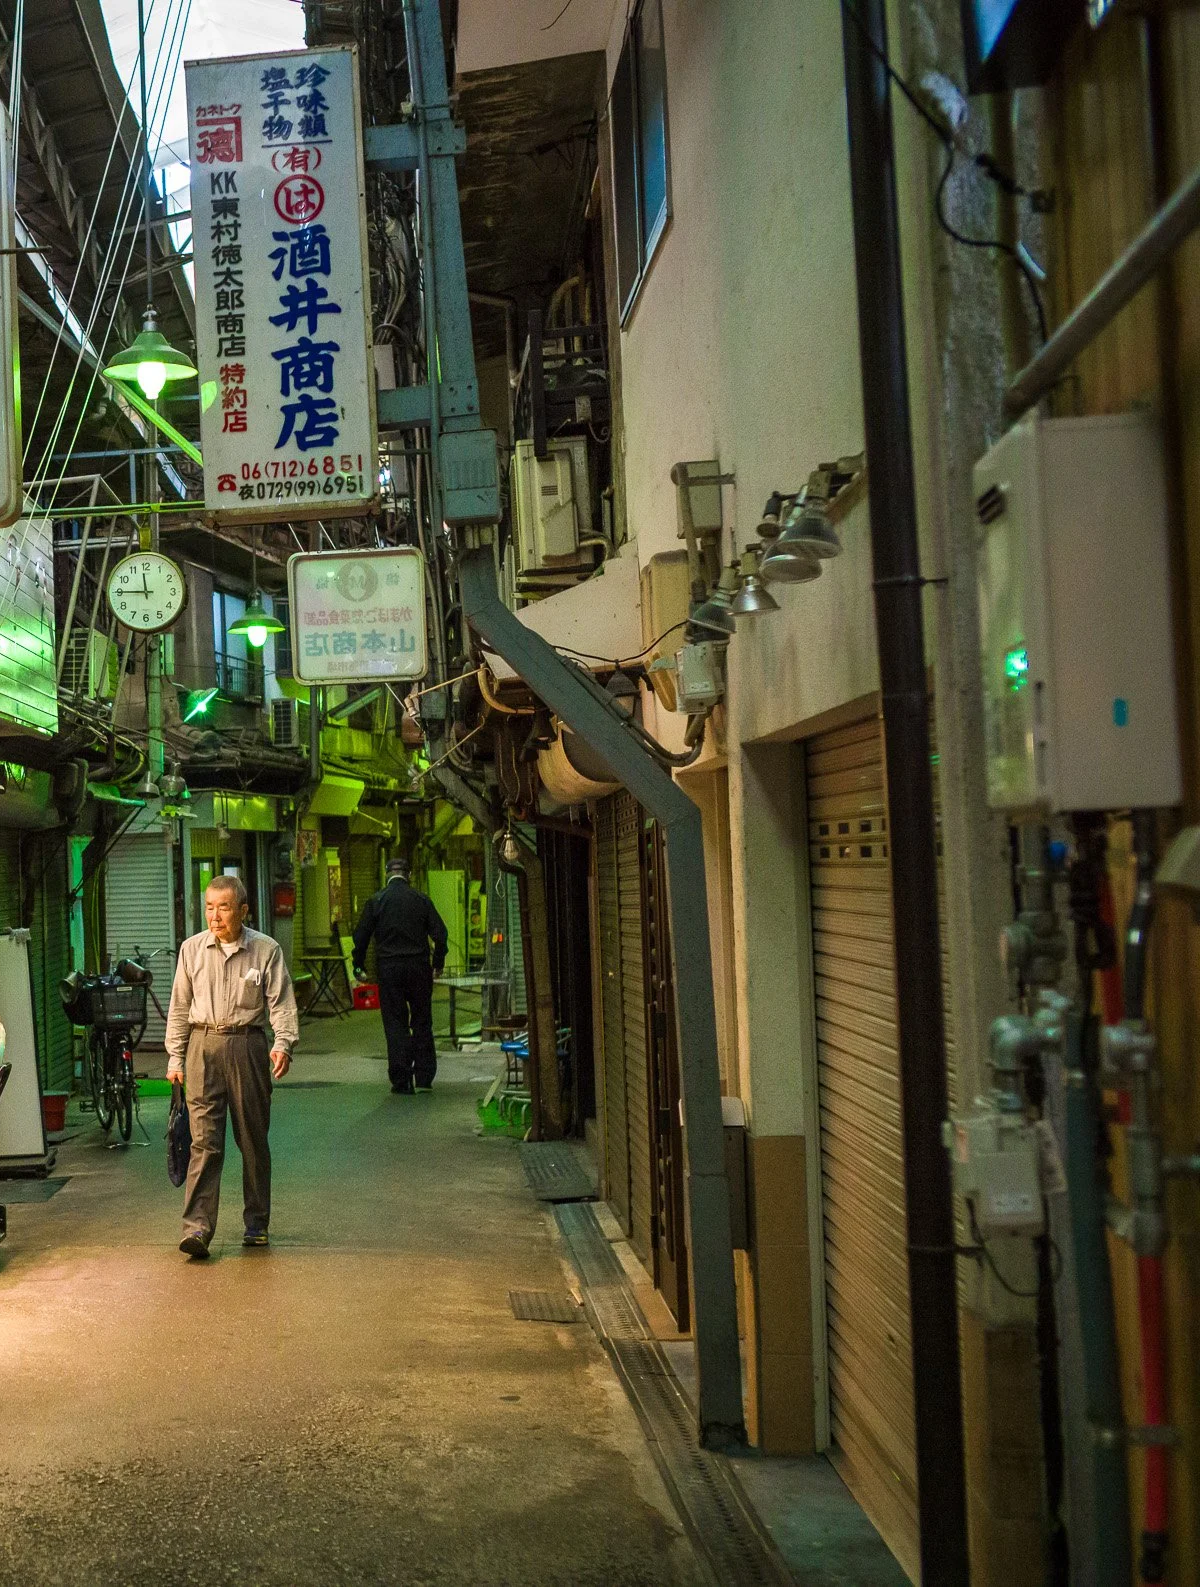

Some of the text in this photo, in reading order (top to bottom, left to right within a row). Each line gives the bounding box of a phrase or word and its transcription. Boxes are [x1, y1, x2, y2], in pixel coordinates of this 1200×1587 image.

[294, 62, 331, 139] 珍味類
[196, 103, 242, 118] カネトク
[268, 223, 342, 452] 酒井商店
[219, 362, 248, 433] 特約店
[241, 454, 363, 481] 06(712)6851
[130, 566, 137, 574] 11
[142, 562, 150, 571] 12
[120, 575, 129, 584] 10
[166, 574, 173, 583] 2
[116, 588, 123, 597] 9
[170, 588, 176, 596] 3
[120, 602, 127, 610] 8
[165, 601, 172, 609] 4
[130, 611, 137, 619] 7
[142, 614, 150, 622] 6
[157, 611, 163, 619] 5
